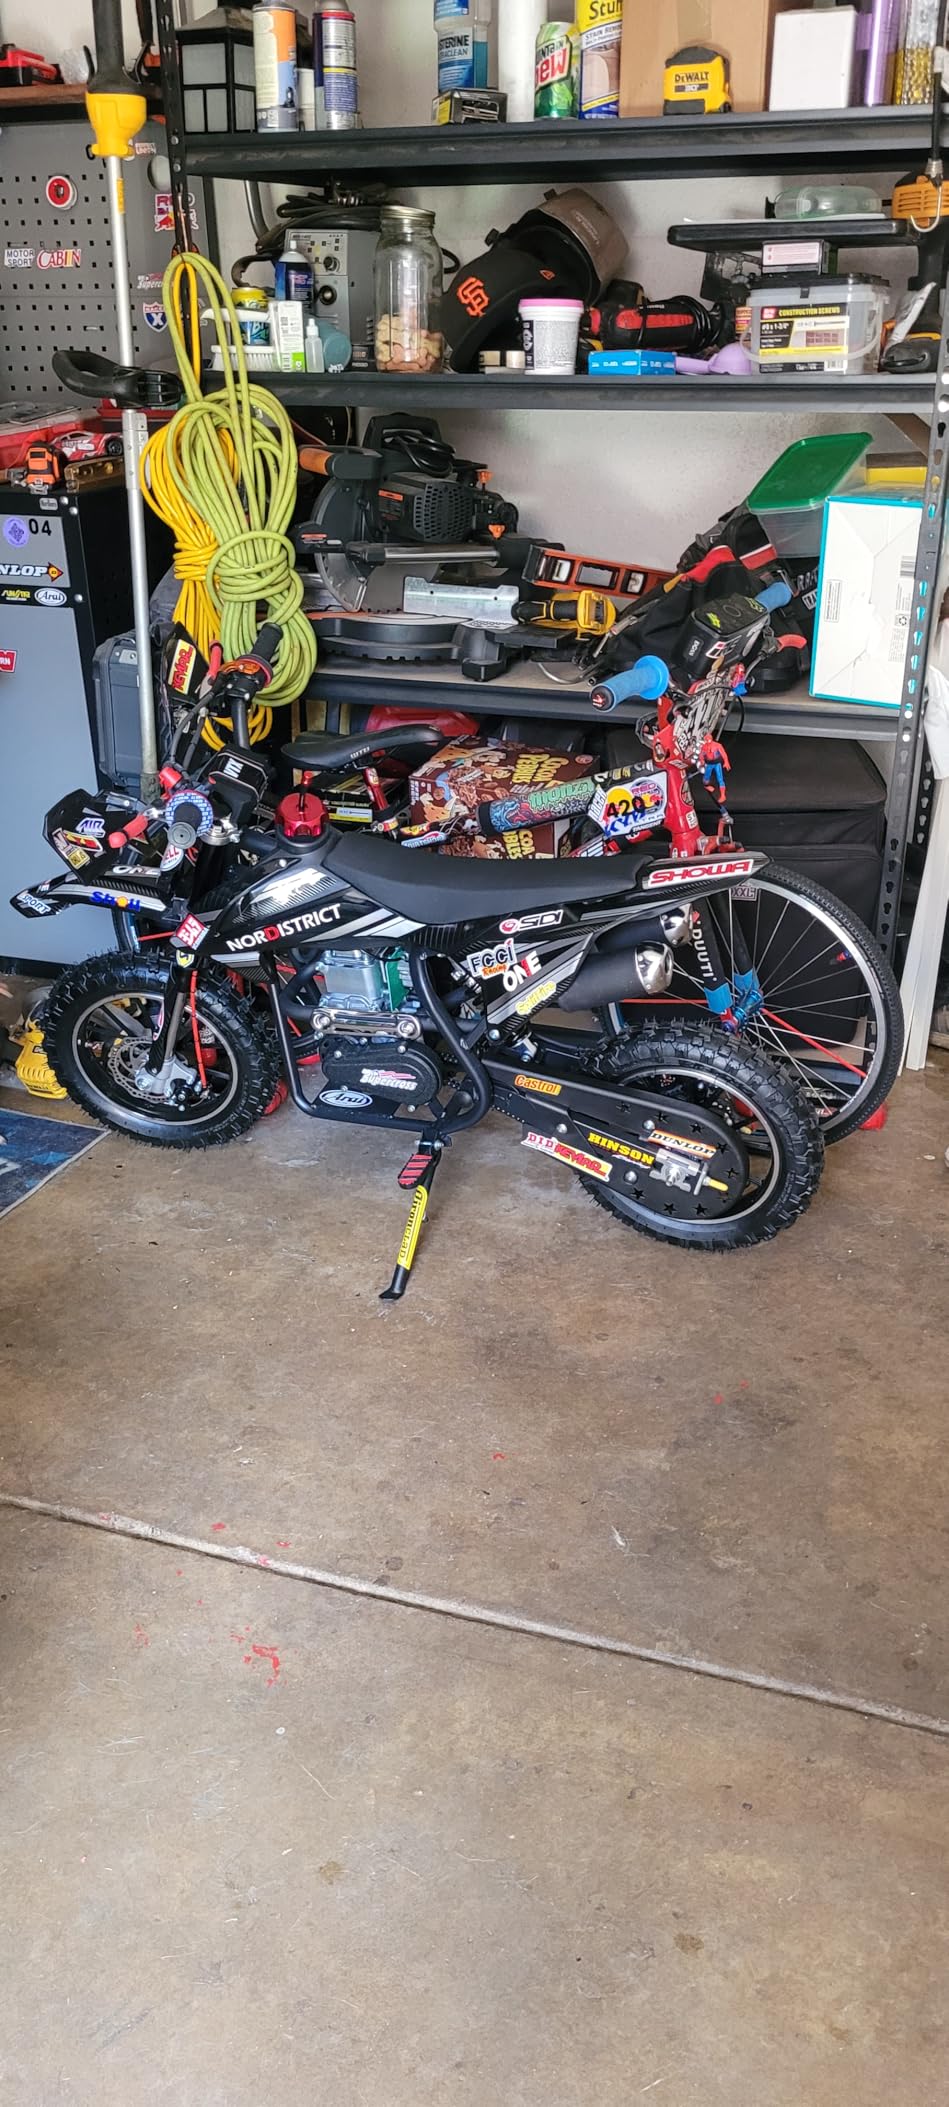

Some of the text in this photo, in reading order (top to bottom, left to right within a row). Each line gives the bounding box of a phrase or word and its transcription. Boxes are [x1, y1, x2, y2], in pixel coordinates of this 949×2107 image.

[588, 0, 622, 20] Stu
[7, 249, 34, 257] MOTOR
[8, 258, 33, 267] SPORT
[38, 250, 81, 268] CABIN
[606, 795, 646, 818] 420
[651, 860, 752, 885] SHOWA
[225, 903, 341, 952] NORDISTRICT
[503, 951, 542, 992] ONE
[515, 1075, 560, 1094] Castrol
[587, 1131, 655, 1165] HINSON
[652, 1131, 715, 1157] DUNLOP
